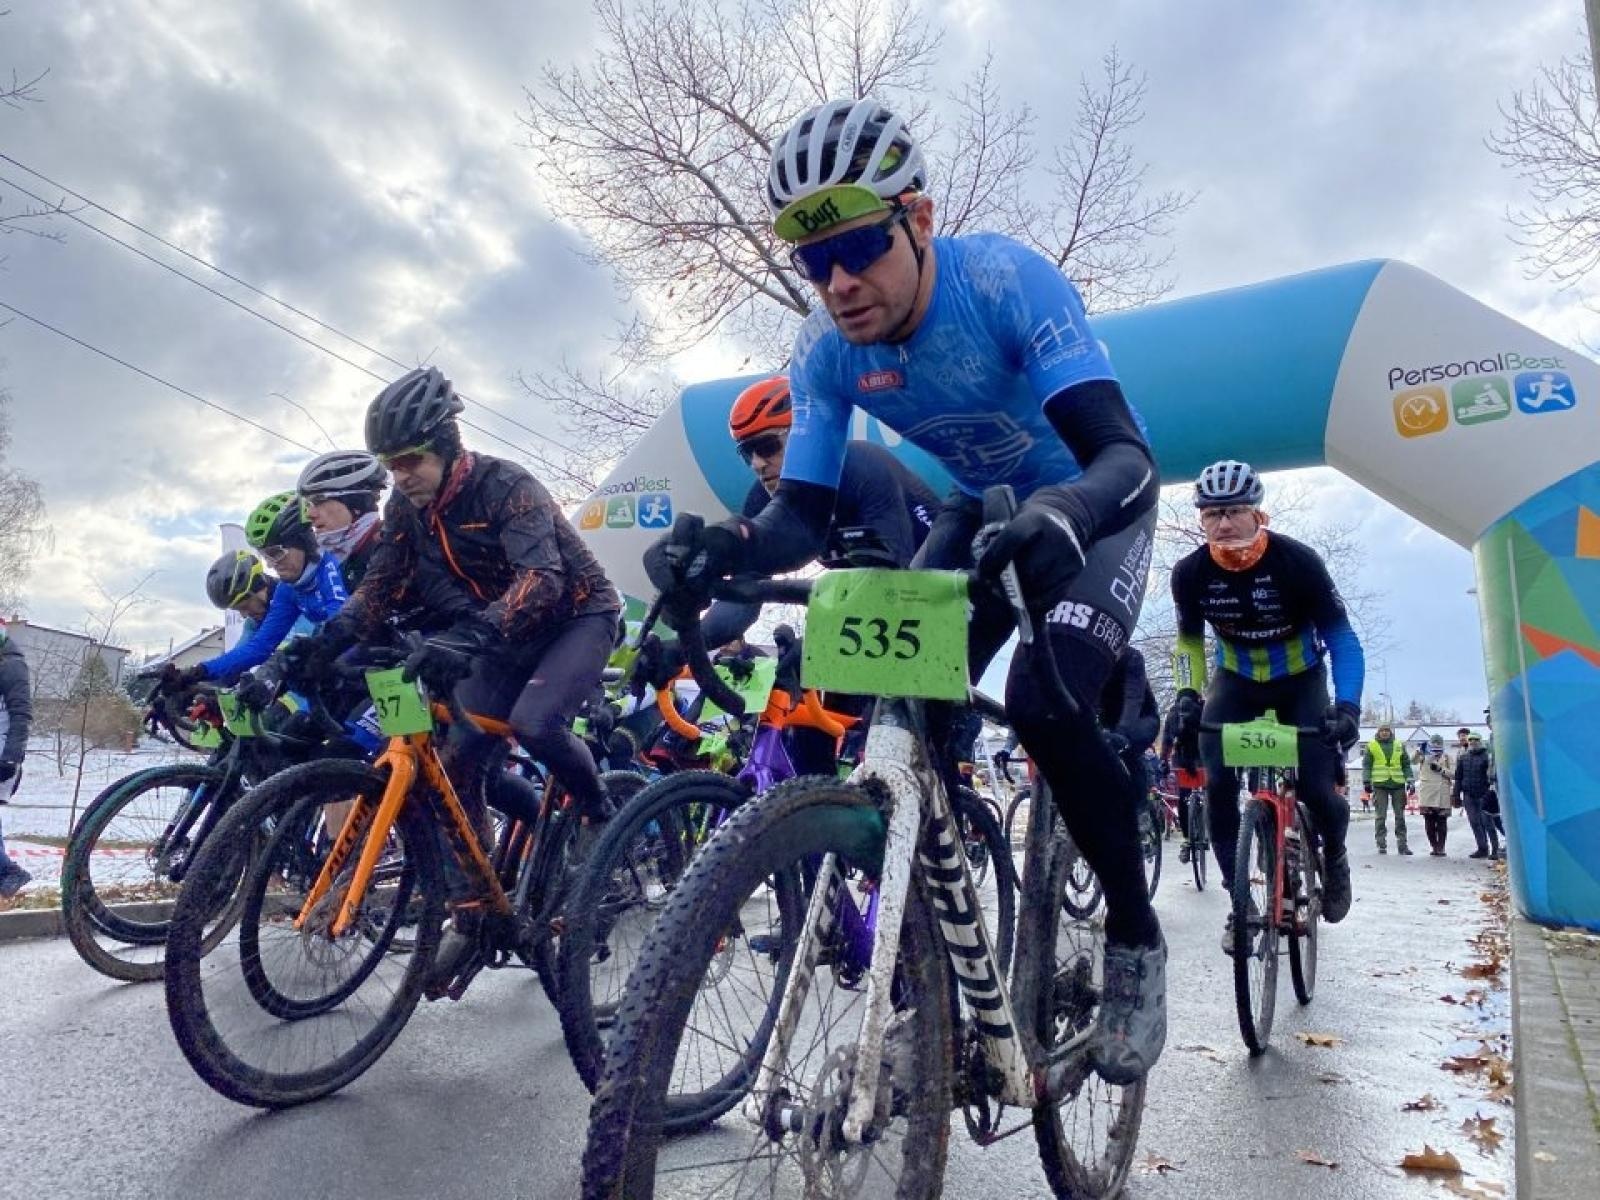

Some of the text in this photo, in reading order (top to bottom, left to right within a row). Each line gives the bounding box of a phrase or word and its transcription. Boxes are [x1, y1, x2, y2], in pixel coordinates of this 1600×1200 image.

[1388, 353, 1567, 390] PersonalBest
[840, 616, 921, 659] 535
[1240, 731, 1277, 749] 536
